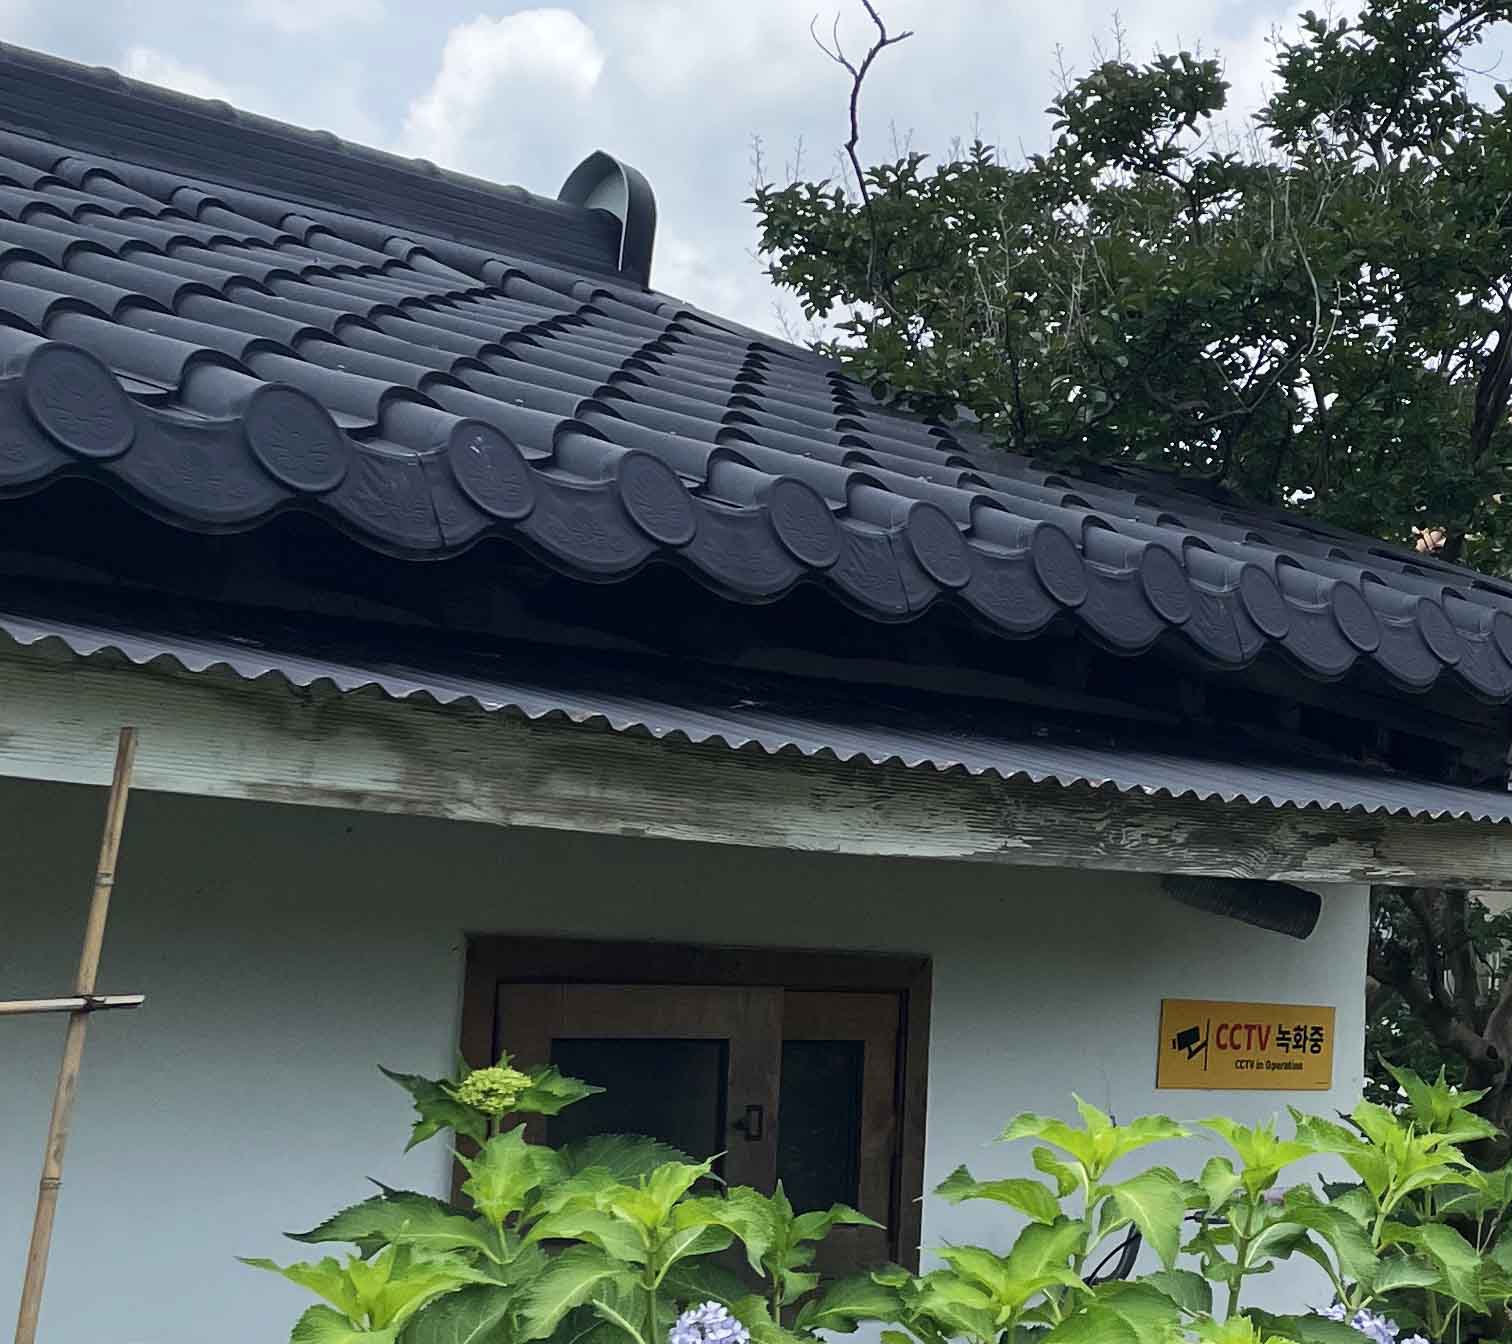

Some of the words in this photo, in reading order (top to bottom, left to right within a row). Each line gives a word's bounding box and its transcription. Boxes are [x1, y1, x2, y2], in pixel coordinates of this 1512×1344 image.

[1215, 1023, 1272, 1051] CCTV
[1276, 1023, 1324, 1054] 녹화중
[1235, 1059, 1255, 1070] CCTV
[1265, 1060, 1304, 1071] Operation
